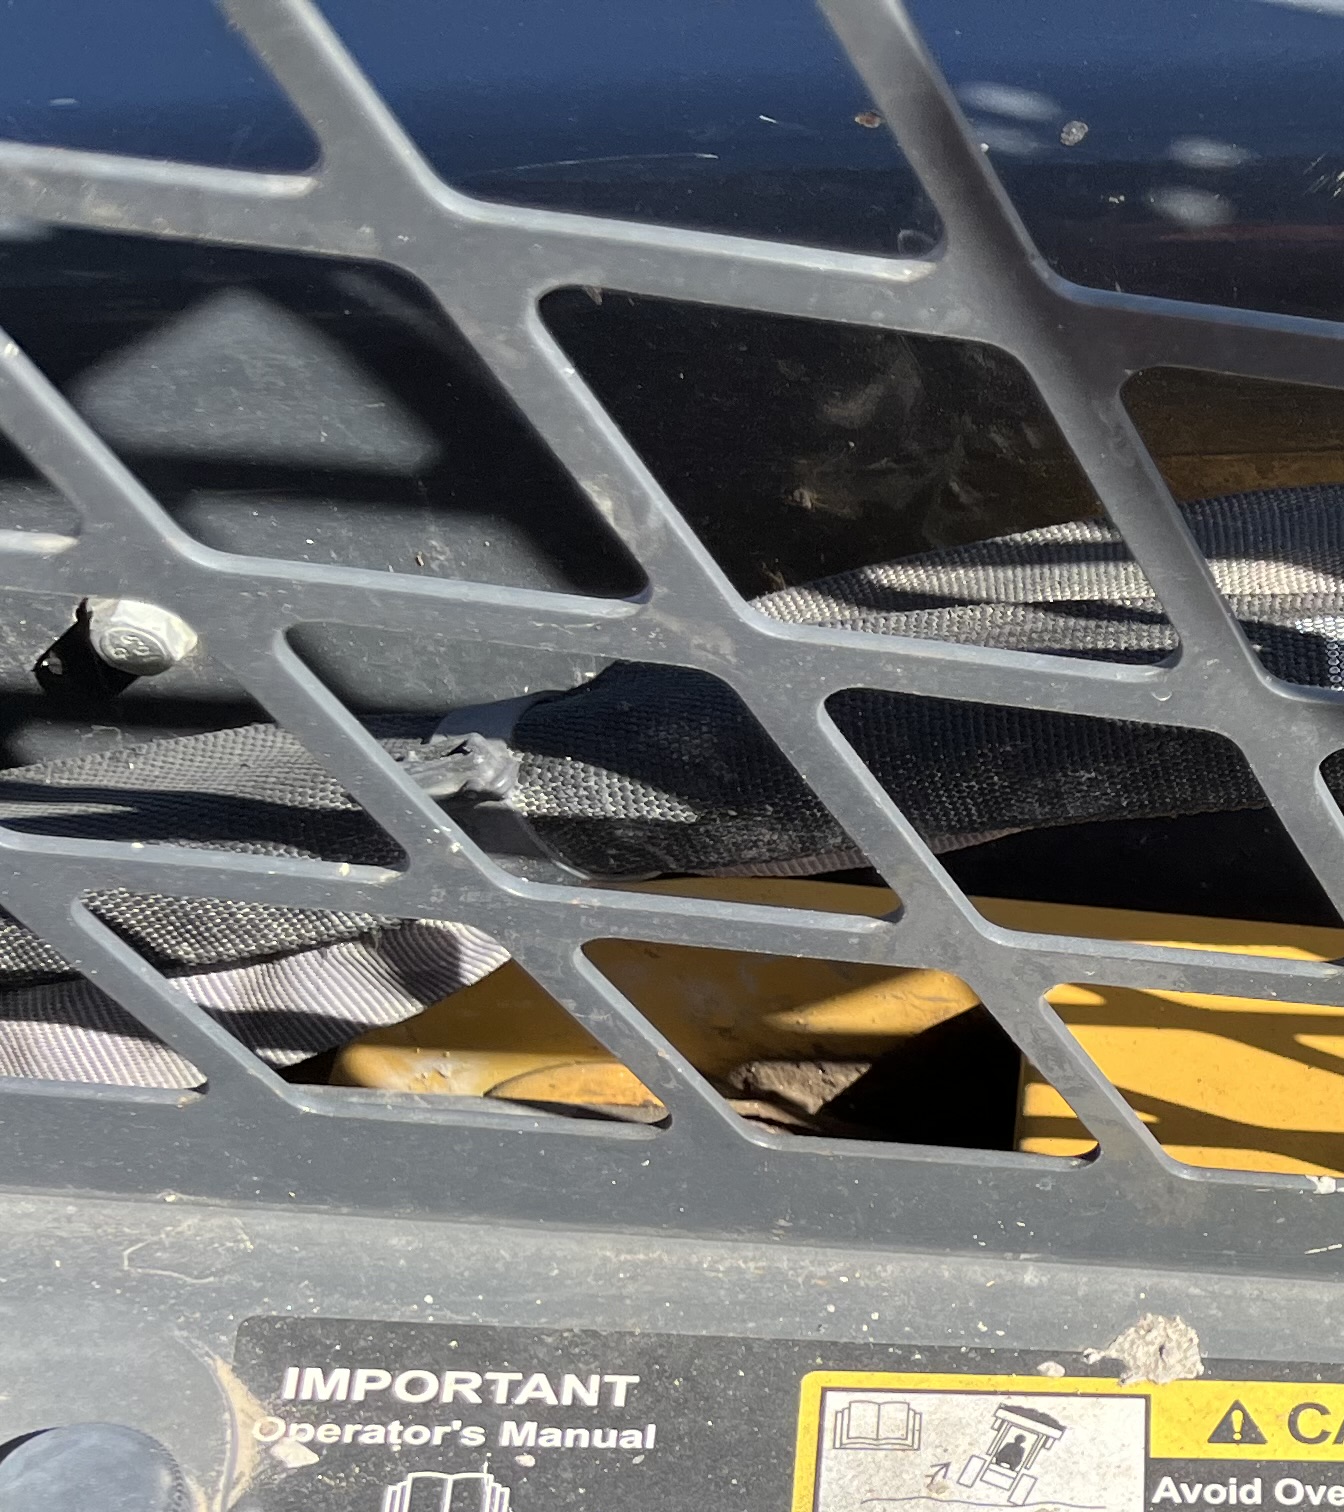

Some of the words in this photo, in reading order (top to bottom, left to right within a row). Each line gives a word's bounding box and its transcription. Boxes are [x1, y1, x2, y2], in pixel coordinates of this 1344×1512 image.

[282, 1366, 640, 1407] IMPORTANT
[252, 1418, 485, 1449] Operator's
[500, 1421, 656, 1449] Manual
[1151, 1476, 1262, 1506] Avoid
